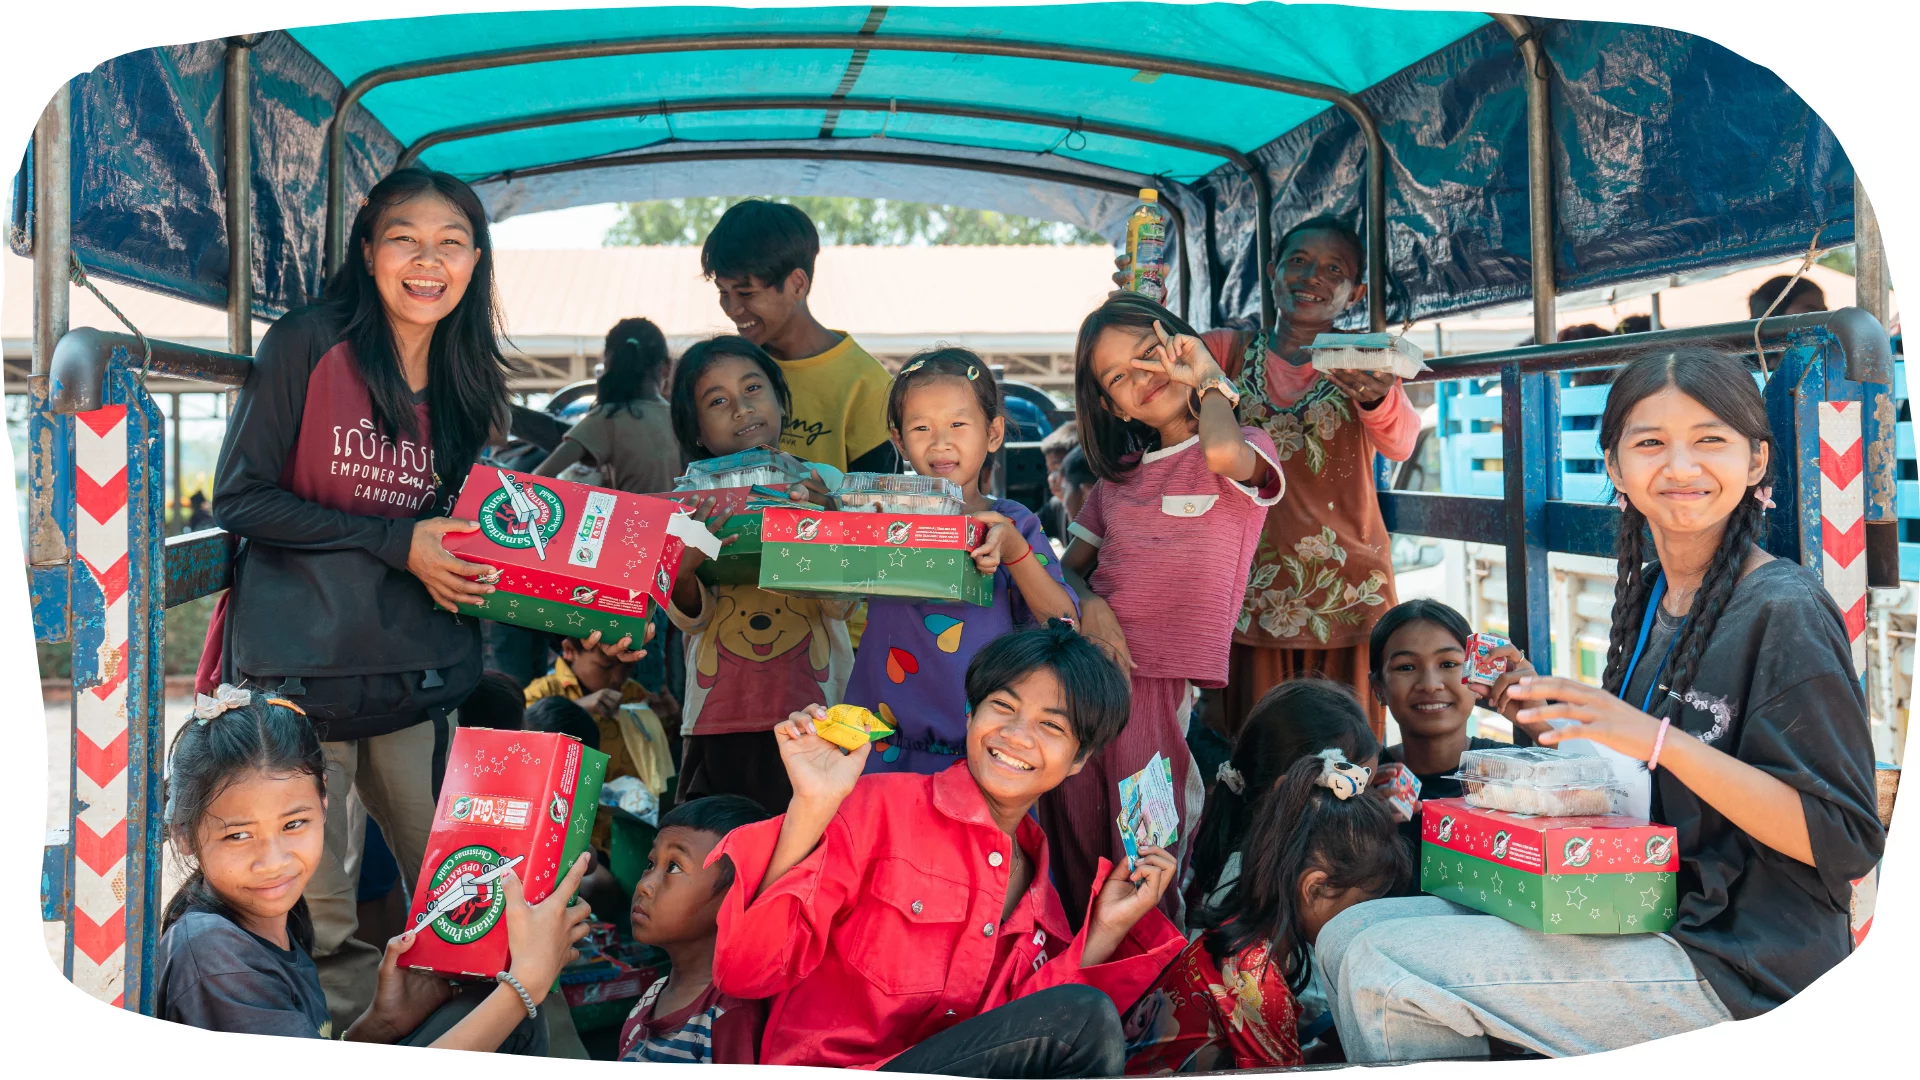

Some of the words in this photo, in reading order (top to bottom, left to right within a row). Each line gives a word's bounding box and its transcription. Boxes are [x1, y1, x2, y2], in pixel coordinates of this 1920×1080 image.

[330, 460, 395, 484] EMPOWER
[354, 483, 417, 510] CAMBODIA
[482, 491, 508, 515] Purse
[525, 487, 550, 523] OPERATION
[539, 488, 557, 504] Child
[547, 502, 562, 532] Christmas
[482, 514, 531, 547] Samaritan's
[470, 797, 494, 822] Girl
[454, 848, 492, 861] Christmas
[433, 863, 480, 898] OPERATION
[436, 859, 455, 881] Child
[437, 917, 462, 941] Purse
